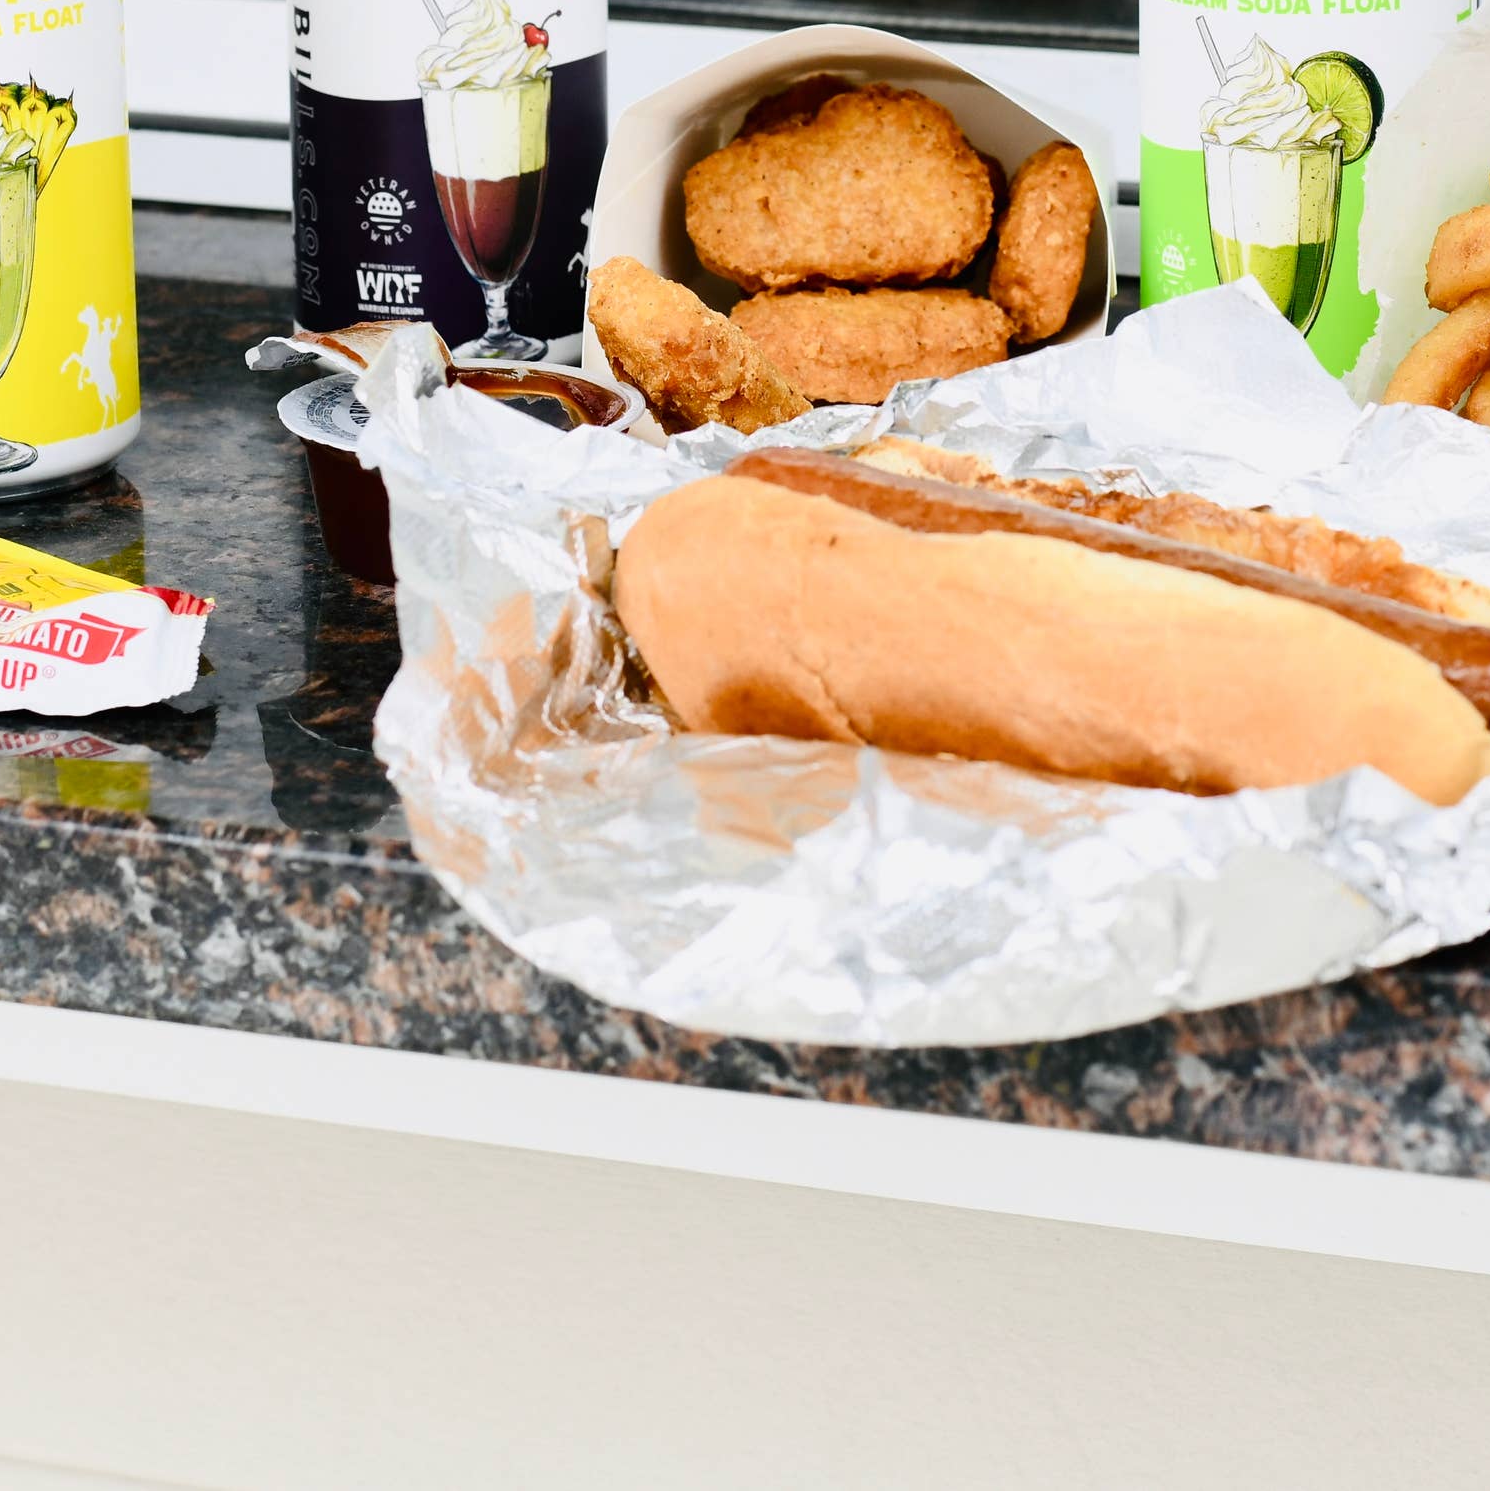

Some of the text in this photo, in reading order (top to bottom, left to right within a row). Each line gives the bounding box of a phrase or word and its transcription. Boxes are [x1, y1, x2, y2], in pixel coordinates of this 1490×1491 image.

[13, 2, 84, 34] FLOAT
[355, 177, 416, 210] VETERAN
[361, 221, 413, 245] OWNED
